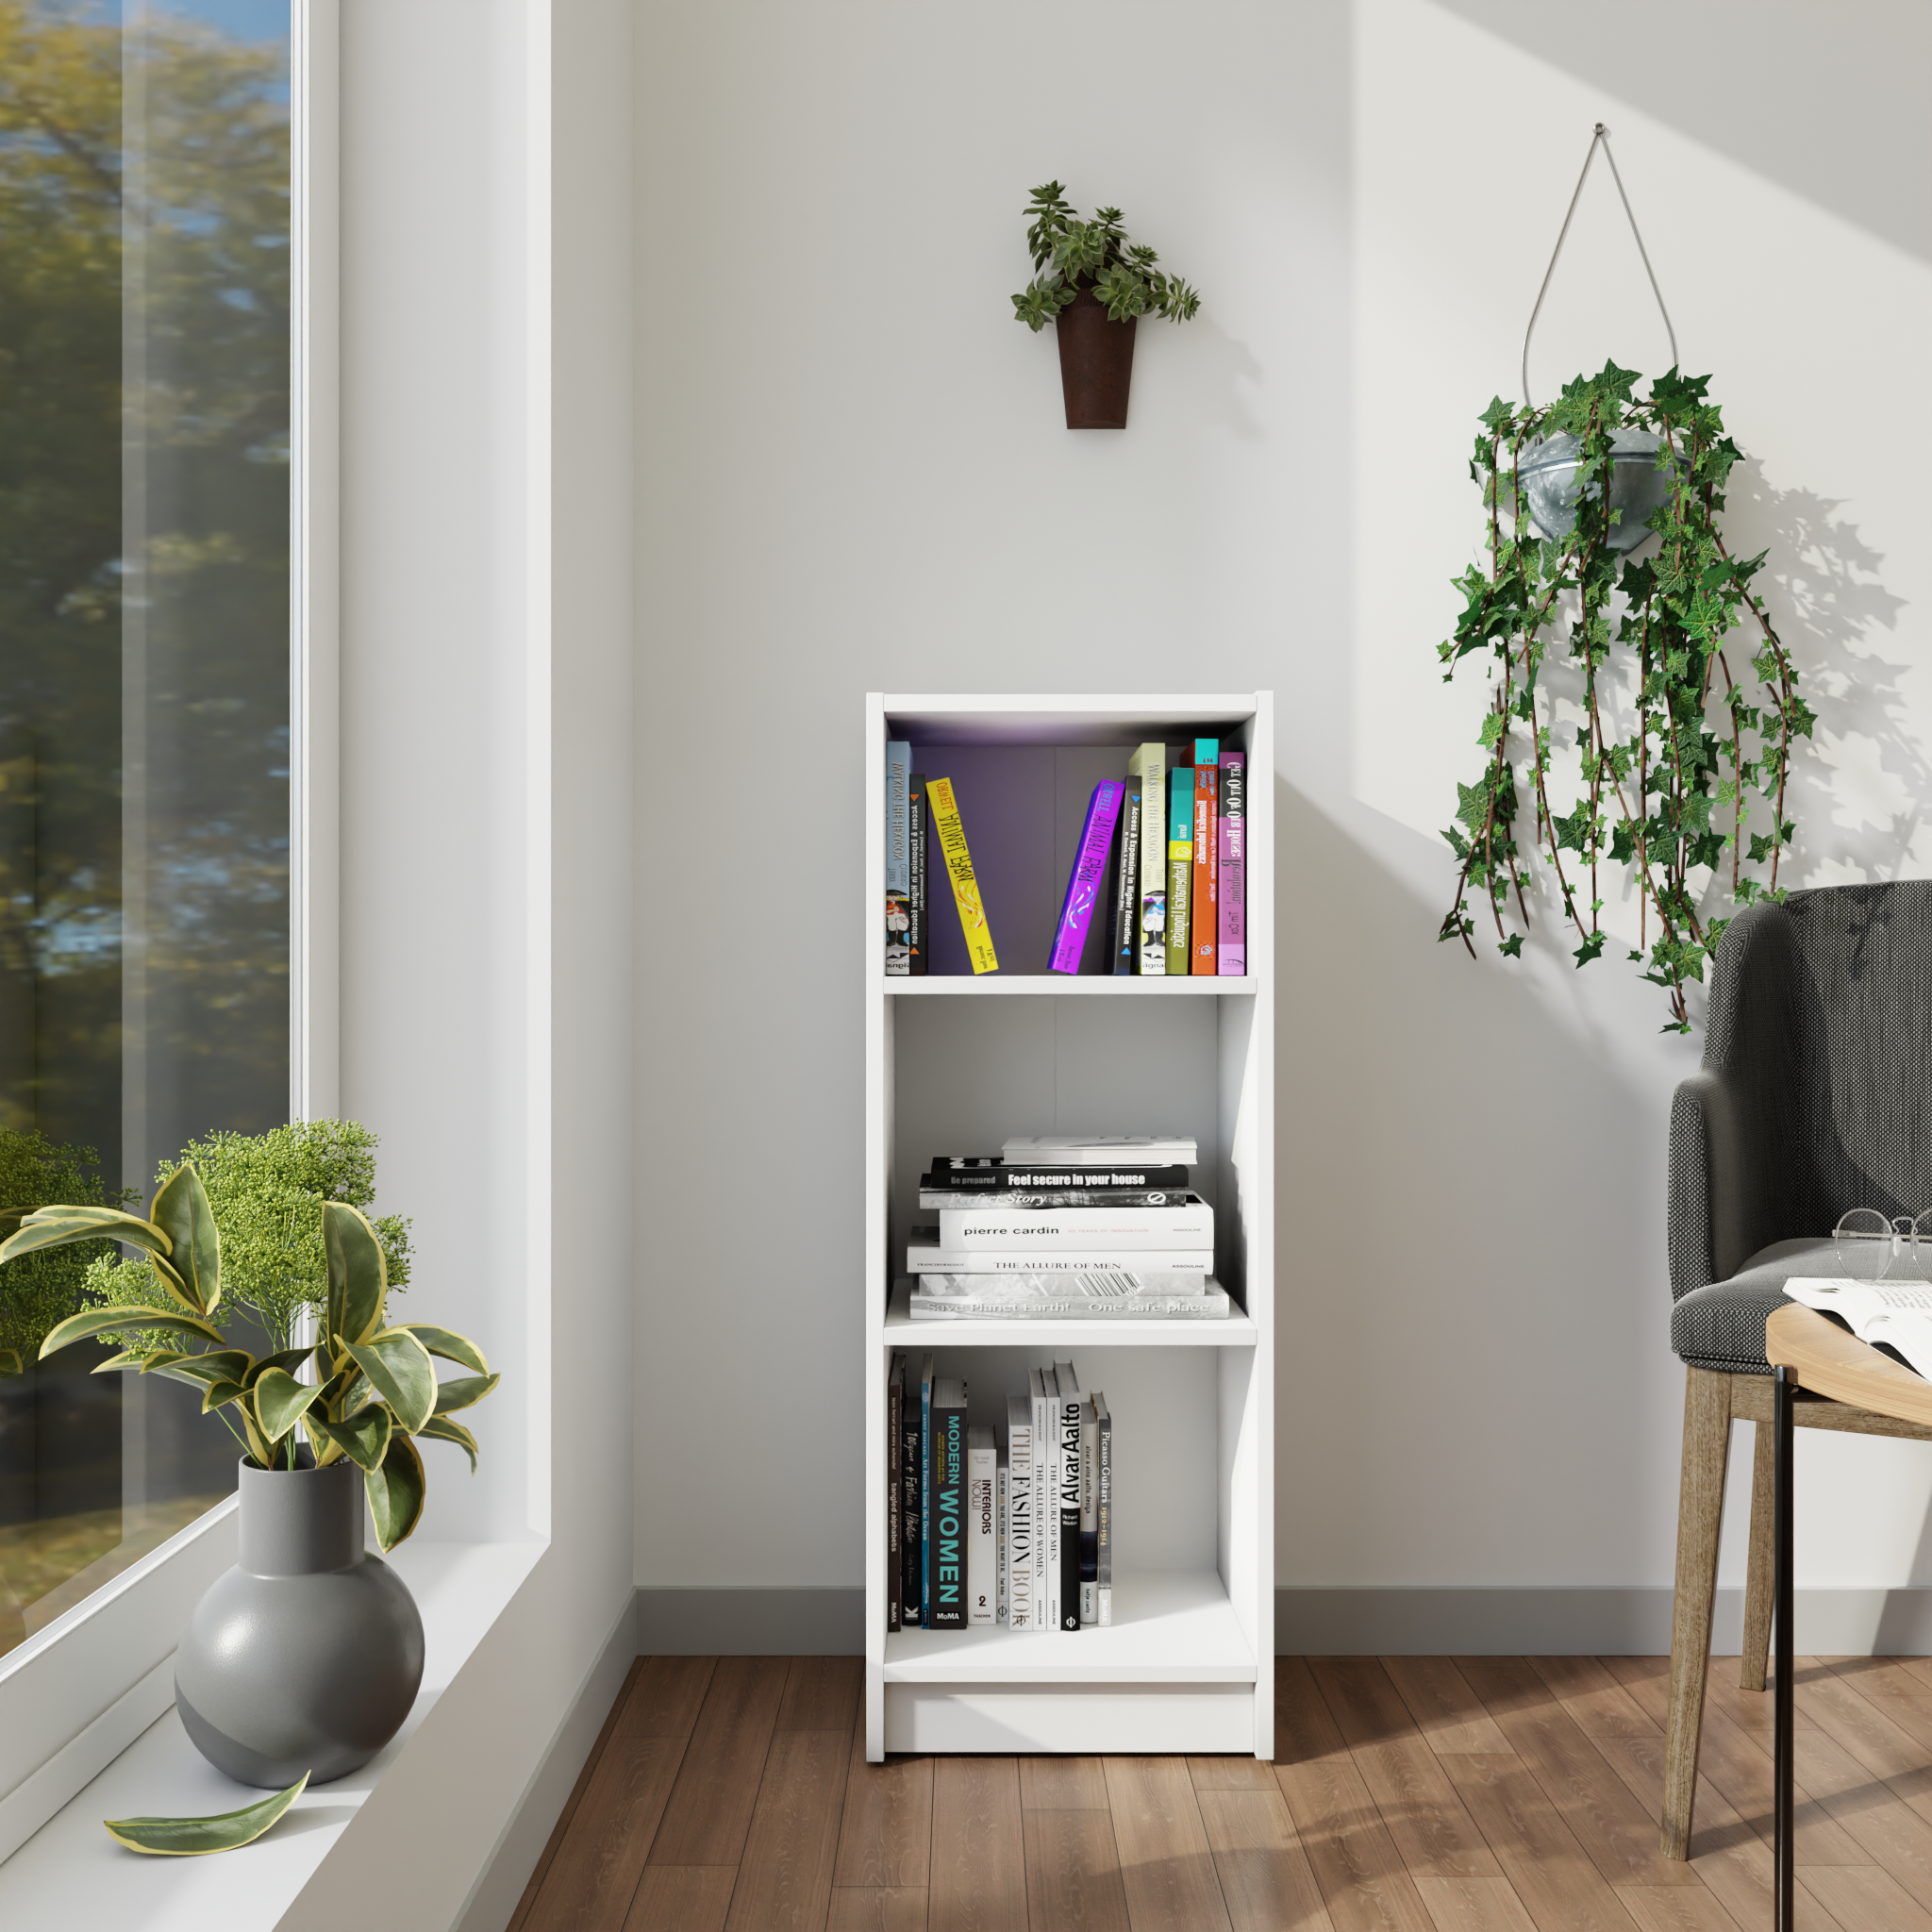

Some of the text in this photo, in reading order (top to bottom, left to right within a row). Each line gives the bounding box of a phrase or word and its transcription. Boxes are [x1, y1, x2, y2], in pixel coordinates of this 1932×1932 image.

[1130, 807, 1139, 831] Access
[1148, 762, 1160, 861] WALKING THE HEXAGON
[1077, 783, 1115, 884] ORWELL ANIMAL FARM
[1127, 840, 1138, 875] Expansion
[1156, 868, 1164, 883] TERRY
[1124, 885, 1135, 909] Higher
[1123, 910, 1133, 945] Education
[961, 1176, 996, 1186] prepared
[1008, 1174, 1146, 1186] Feel secure in your house
[948, 1192, 1048, 1207] Perfect Story
[964, 1227, 1008, 1236] pierre
[926, 1302, 1211, 1314] Save Planet Earth! One safe place
[1062, 1404, 1080, 1504] Alvar Aalto
[1101, 1431, 1111, 1504] Picasso Guitars
[905, 1476, 918, 1507] Fashion
[972, 1479, 982, 1510] NOW!
[982, 1479, 991, 1535] INTERIORS
[1084, 1496, 1092, 1514] design
[890, 1482, 898, 1552] tangled alphabets
[939, 1415, 959, 1603] MODERN WOMEN
[1036, 1463, 1044, 1578] THE ALLURE OF WOMEN
[1011, 1428, 1031, 1627] THE FASHION BOOK
[1050, 1525, 1057, 1538] OF
[979, 1596, 986, 1607] 2
